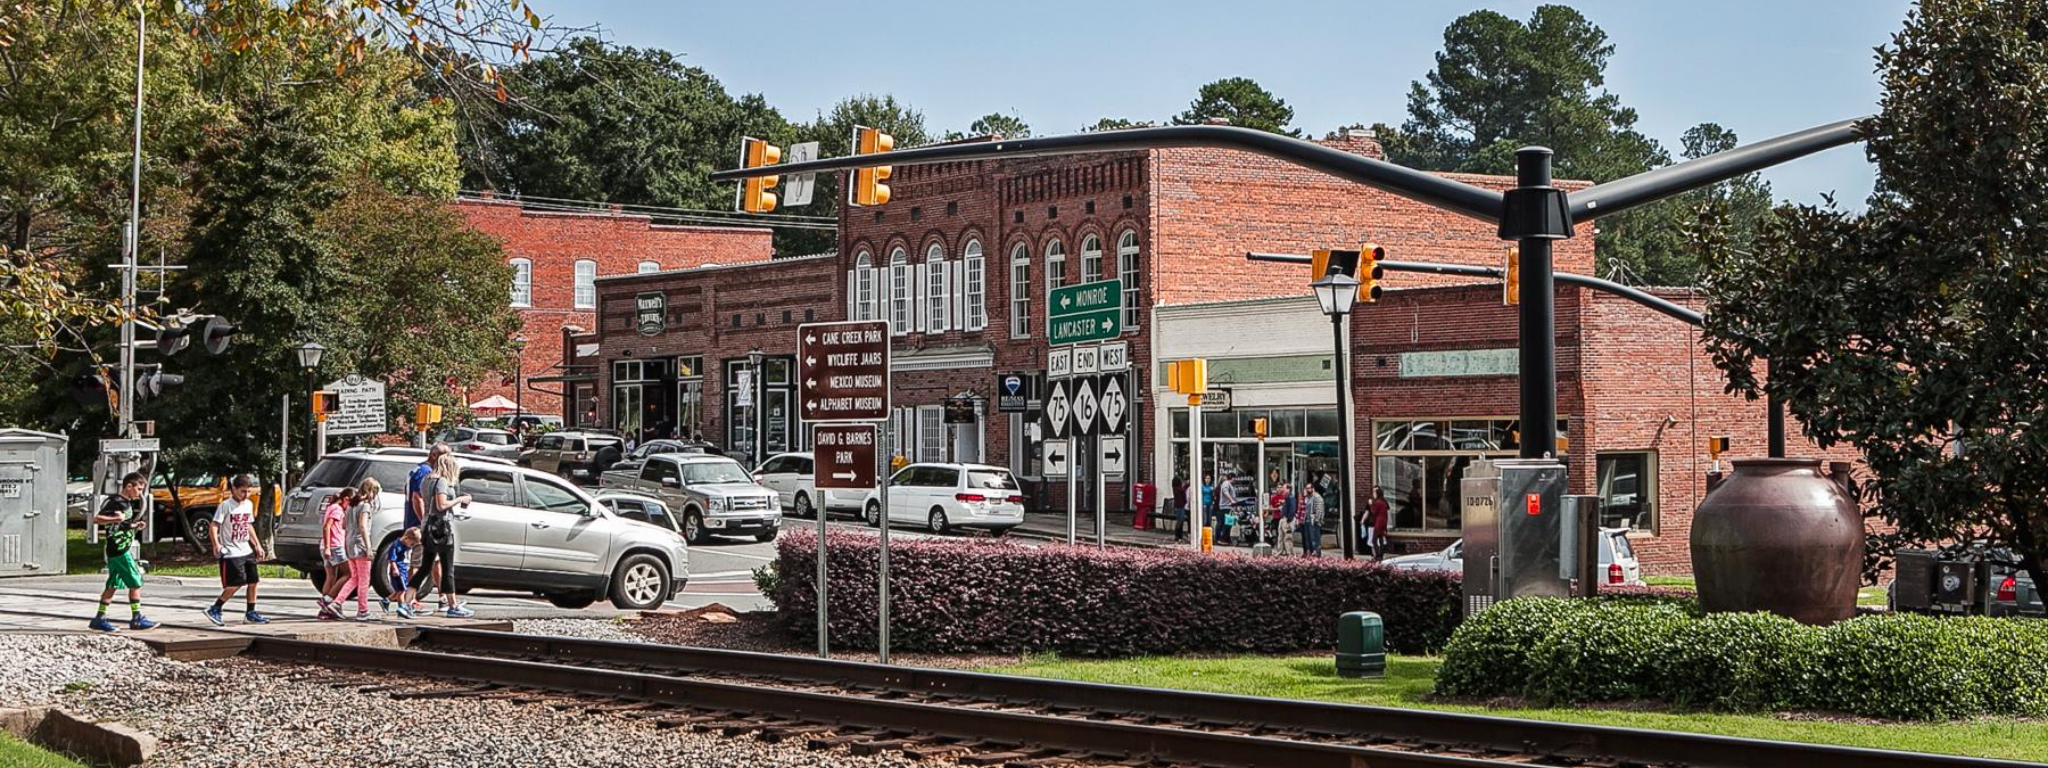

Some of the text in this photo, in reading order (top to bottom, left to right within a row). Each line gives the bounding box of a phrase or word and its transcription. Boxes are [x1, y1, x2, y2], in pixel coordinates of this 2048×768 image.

[1075, 286, 1108, 307] MONROE
[1054, 318, 1096, 339] LANCASTER
[822, 330, 882, 345] CANE CREEK PARK
[827, 352, 882, 367] WYCLIFFE JAARS
[1051, 354, 1068, 371] EAST
[1078, 352, 1094, 369] END
[1103, 348, 1123, 366] WEST
[830, 375, 882, 389] MEXICO MUSEUM
[820, 397, 882, 411] ALPHABET MUSEUM
[1106, 391, 1121, 418] 75
[1202, 392, 1226, 401] WELRY
[1053, 396, 1065, 422] 75
[1080, 394, 1092, 420] 16
[817, 432, 836, 445] DAVID
[846, 432, 873, 445] BARNES
[835, 451, 853, 464] PARK
